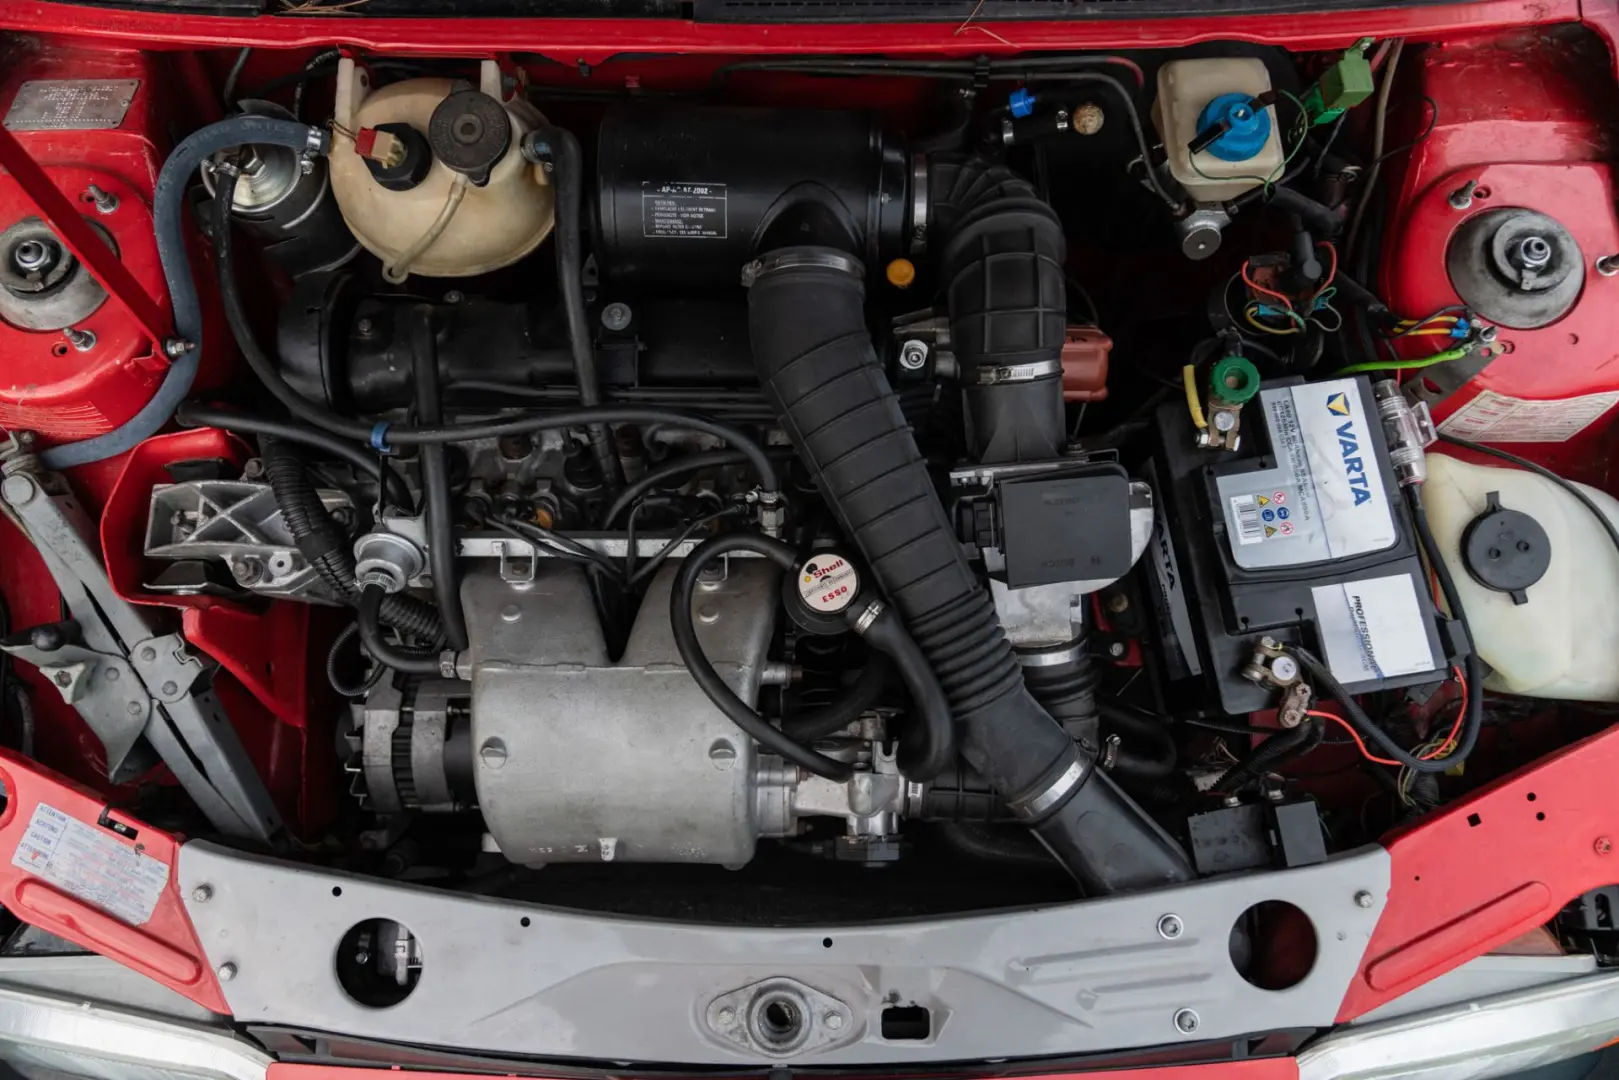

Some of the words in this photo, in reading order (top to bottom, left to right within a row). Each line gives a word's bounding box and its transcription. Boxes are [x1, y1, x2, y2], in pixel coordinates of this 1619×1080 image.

[1336, 421, 1371, 506] VARTA
[814, 560, 844, 578] Shell
[822, 586, 847, 602] ESSO
[1352, 595, 1377, 669] PROFESSIONAL
[40, 805, 66, 822] ATTENTION
[30, 831, 52, 846] CAUTION
